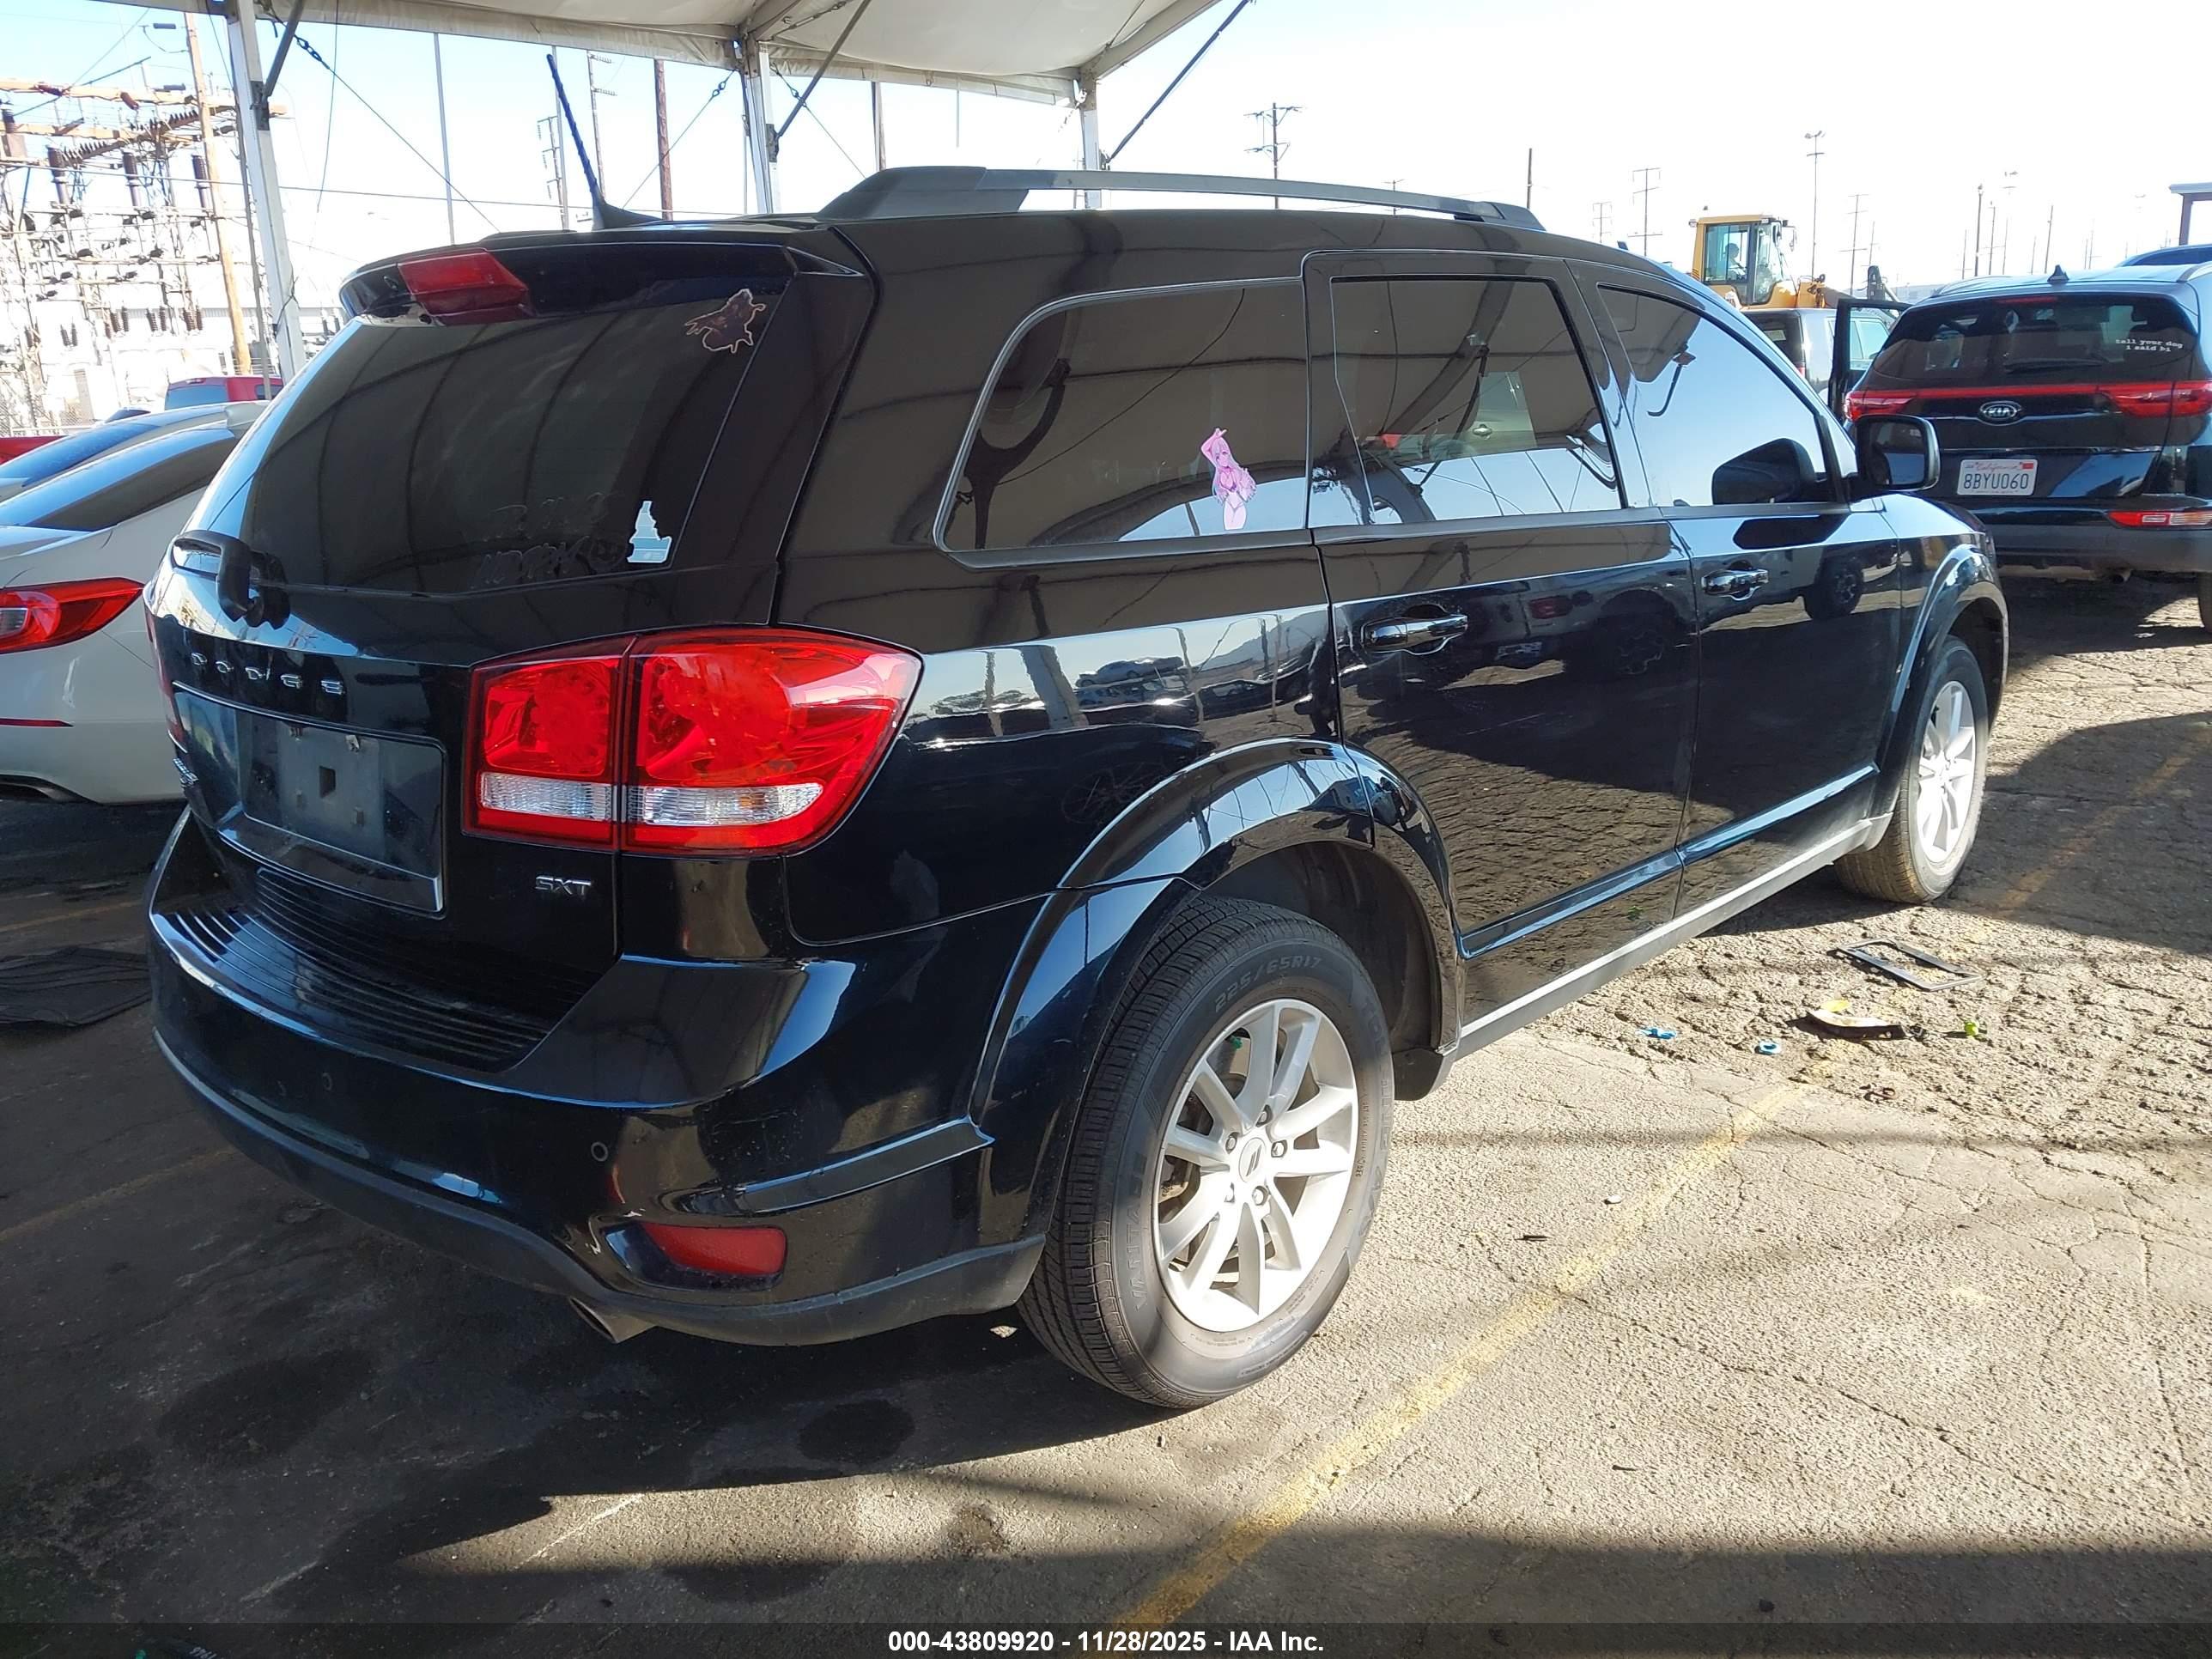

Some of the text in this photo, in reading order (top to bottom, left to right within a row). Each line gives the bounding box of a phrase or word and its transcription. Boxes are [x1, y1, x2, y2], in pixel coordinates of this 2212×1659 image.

[2166, 340, 2183, 349] dog
[1963, 473, 2030, 489] 8BYU060
[191, 652, 345, 696] DODGE
[535, 876, 592, 896] SXT
[1214, 954, 1323, 1013] 225/65R17
